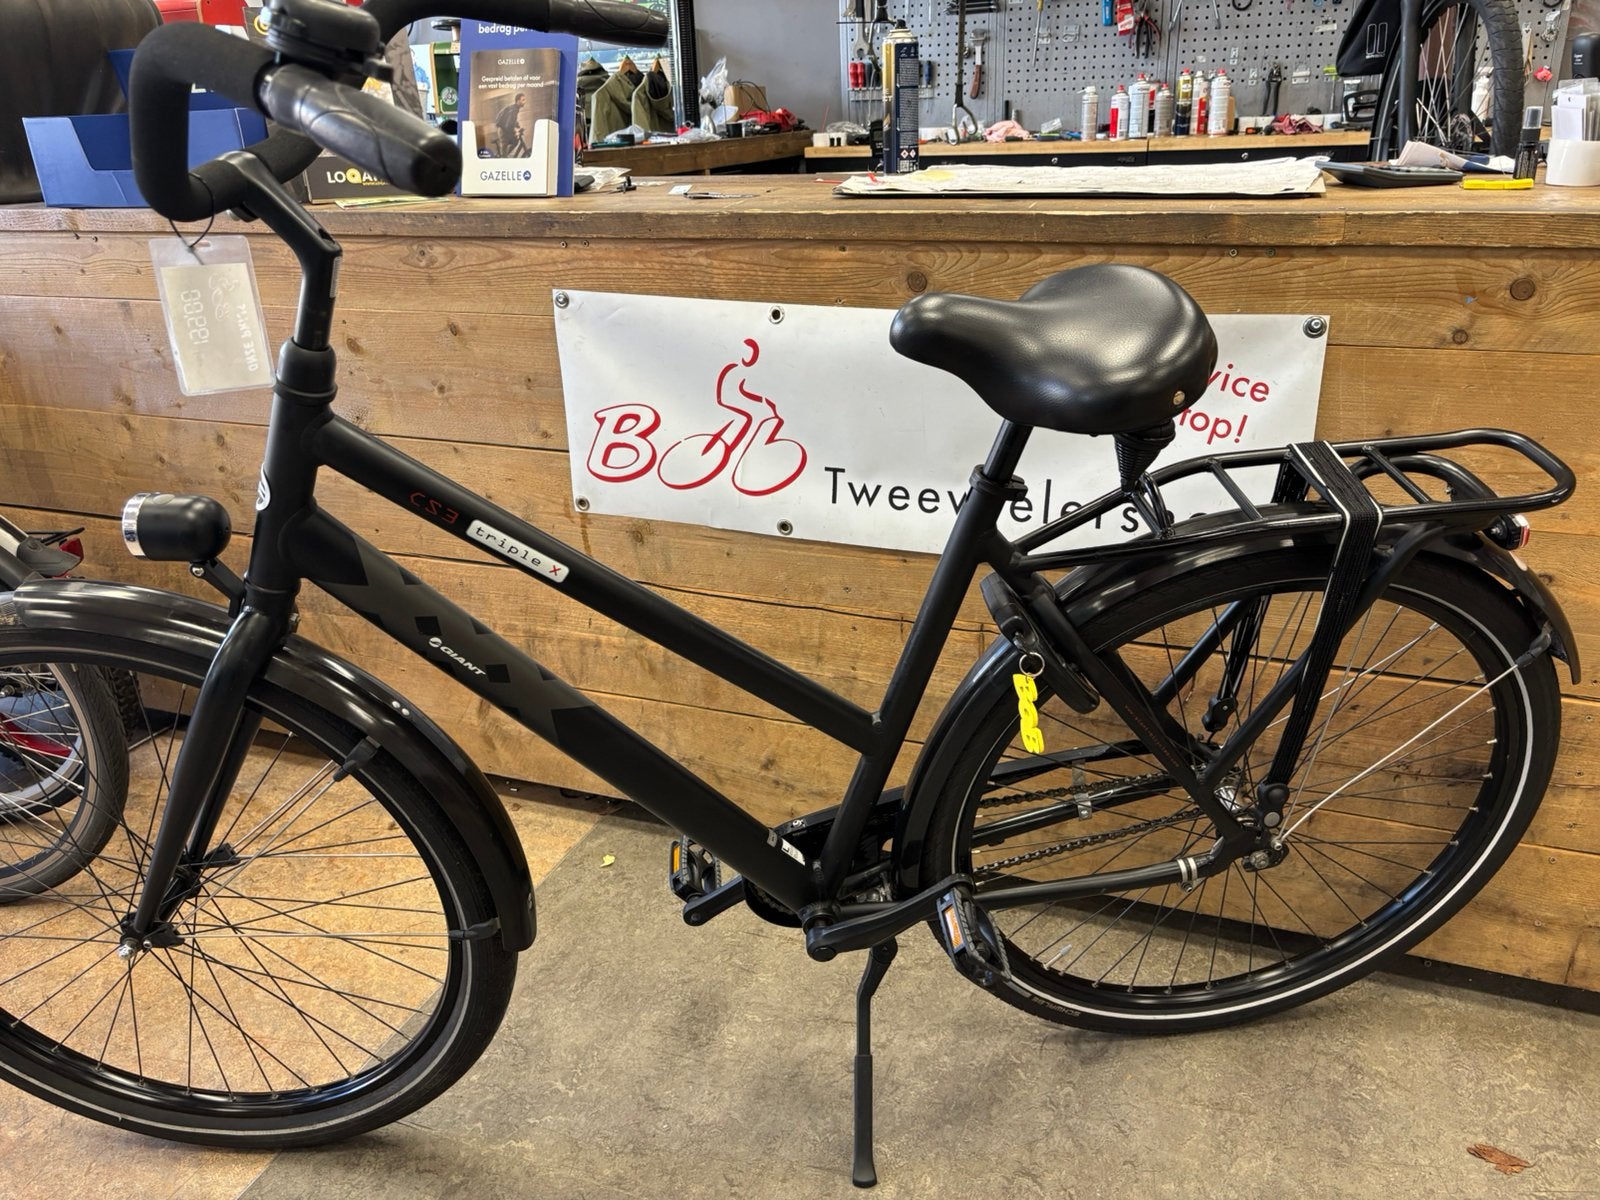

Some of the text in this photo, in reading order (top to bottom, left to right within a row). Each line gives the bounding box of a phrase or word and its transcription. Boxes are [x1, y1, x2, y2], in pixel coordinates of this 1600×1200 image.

[478, 23, 511, 35] bedrag
[480, 170, 523, 181] GAZELLE
[475, 525, 542, 567] triple
[440, 646, 486, 675] GIANT
